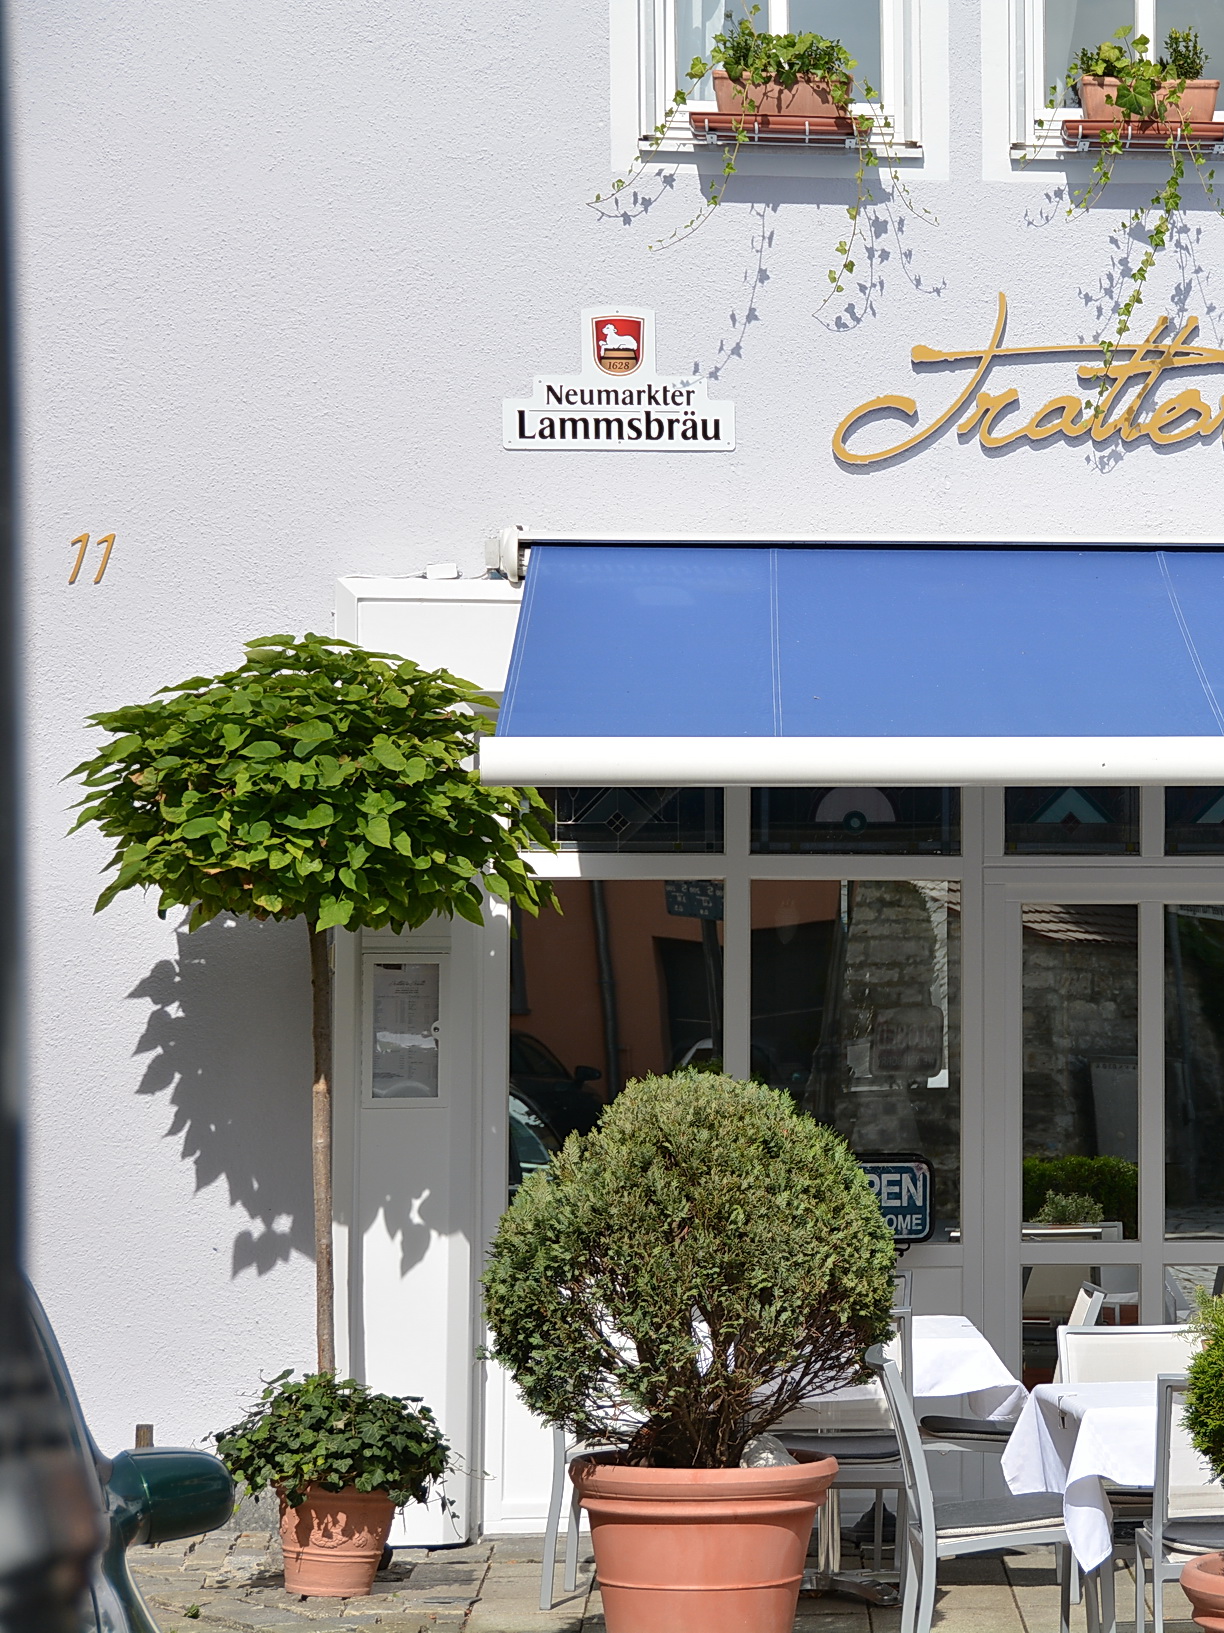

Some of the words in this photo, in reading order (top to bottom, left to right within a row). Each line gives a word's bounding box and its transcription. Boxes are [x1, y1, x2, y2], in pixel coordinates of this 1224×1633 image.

[607, 361, 630, 370] 1628
[546, 384, 695, 406] Neumarkter
[517, 409, 721, 441] Lammsbräu
[68, 532, 116, 585] 11
[868, 1173, 923, 1207] PEN
